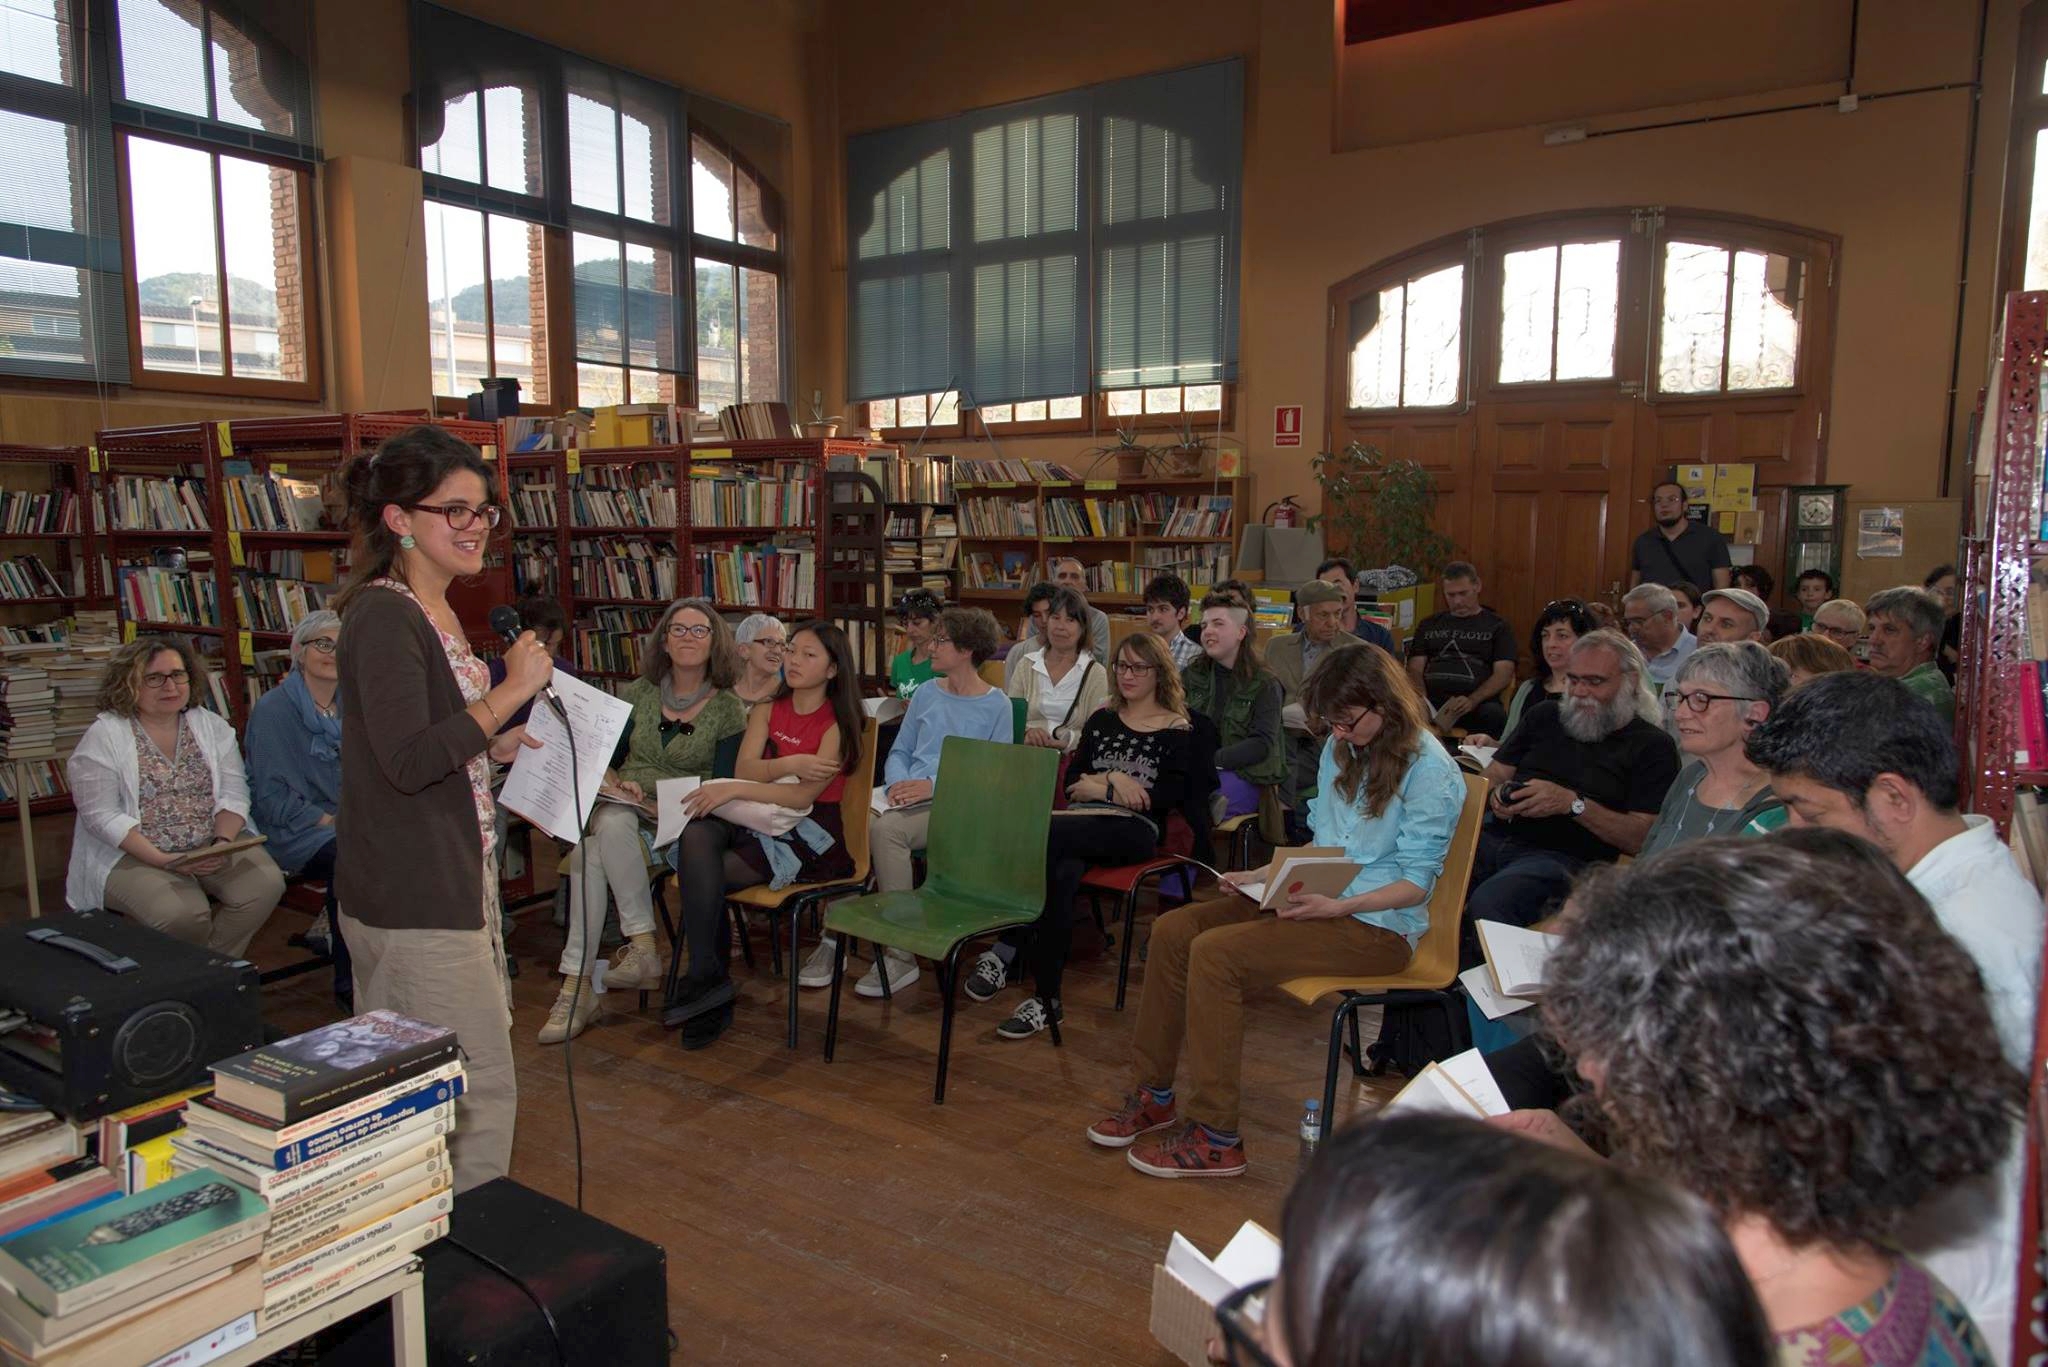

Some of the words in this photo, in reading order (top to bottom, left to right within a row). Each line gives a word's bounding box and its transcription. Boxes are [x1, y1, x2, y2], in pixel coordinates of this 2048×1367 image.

[1452, 630, 1493, 641] FLOYD
[338, 1116, 369, 1134] carrero
[371, 1111, 382, 1121] de
[307, 1130, 337, 1148] blanco
[345, 1130, 356, 1139] un
[357, 1125, 368, 1136] de
[307, 1136, 343, 1156] ministro
[312, 1149, 341, 1168] ESPAÑA
[269, 1167, 300, 1186] FRANCO
[302, 1224, 338, 1245] MEMORIAS
[376, 1244, 396, 1258] García
